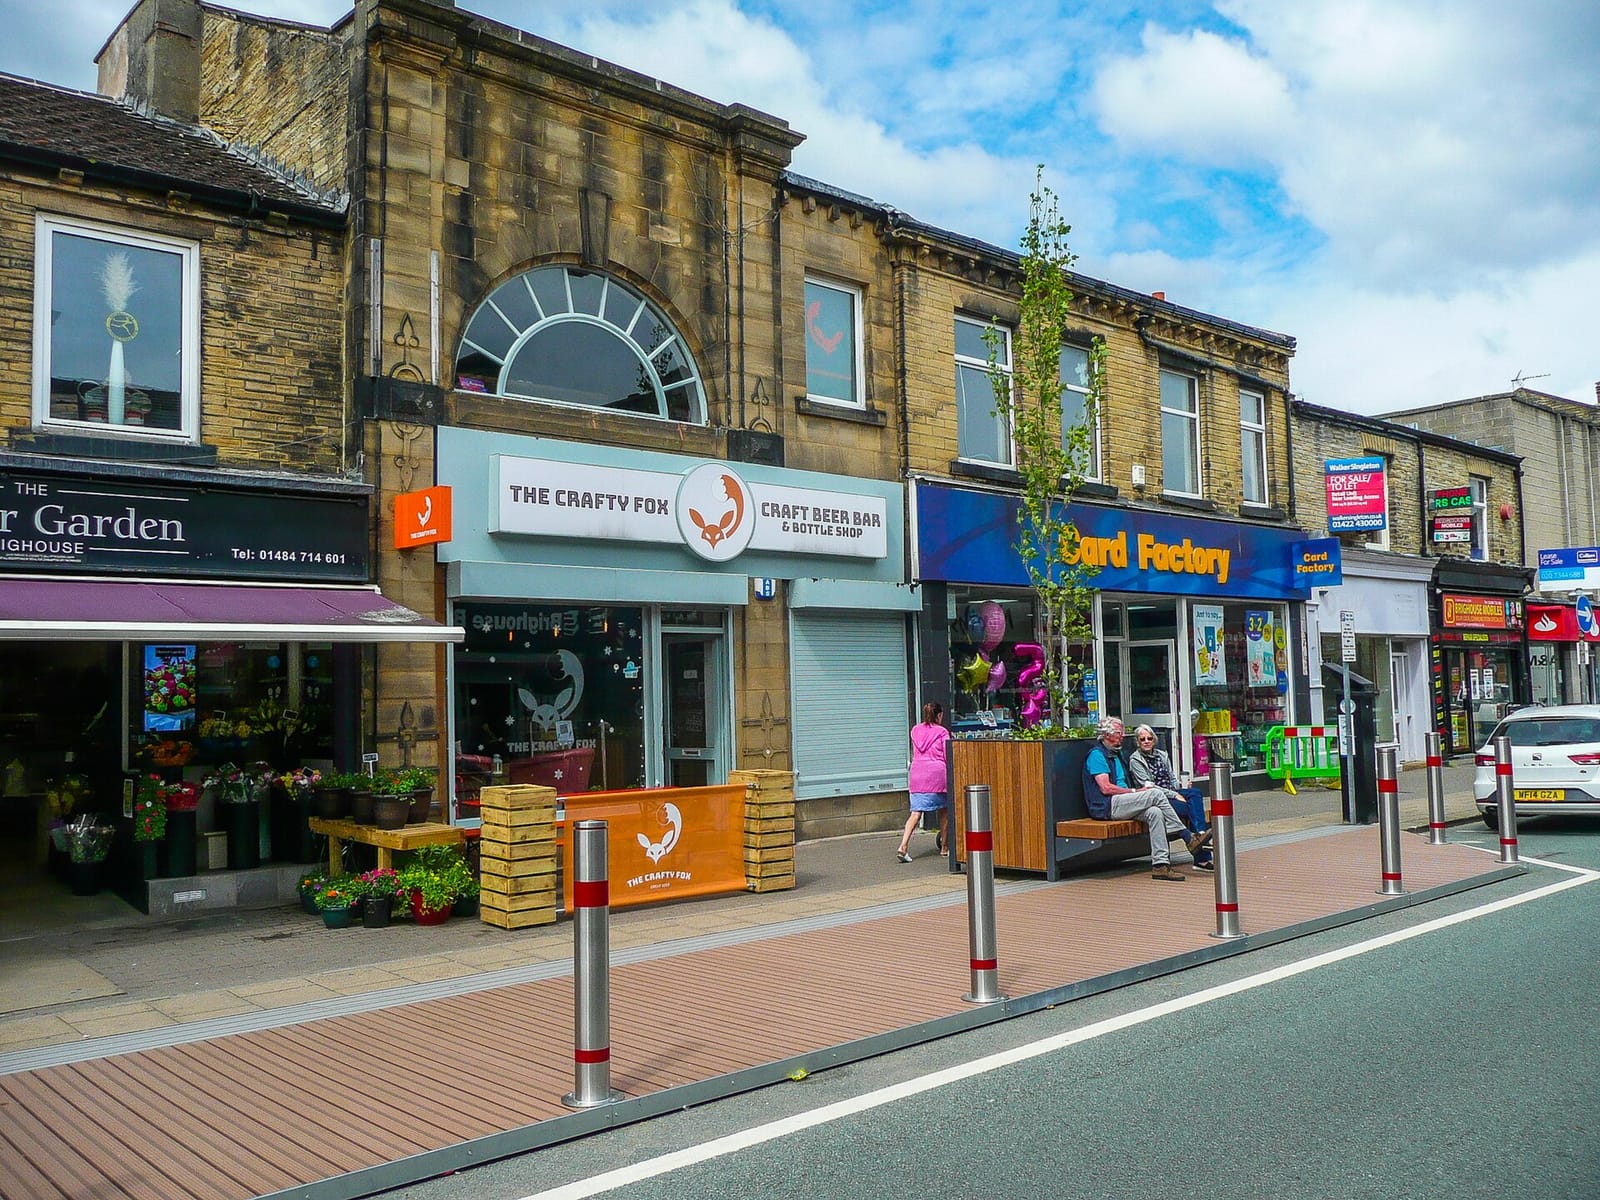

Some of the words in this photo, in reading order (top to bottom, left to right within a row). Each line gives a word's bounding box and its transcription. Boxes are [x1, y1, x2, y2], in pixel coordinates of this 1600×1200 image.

[1330, 475, 1346, 484] FOR
[14, 482, 48, 496] THE
[509, 485, 550, 505] THE
[555, 489, 629, 511] CRAFTY
[633, 497, 669, 515] FOX
[34, 504, 186, 542] Garden
[761, 502, 809, 521] CRAFT
[812, 507, 850, 525] BEER
[853, 511, 881, 528] BAR
[782, 521, 791, 532] &
[792, 523, 834, 536] BOTTLE
[836, 526, 863, 538] SHOP
[231, 548, 256, 561] Tel:
[259, 550, 297, 561] 01484
[300, 552, 321, 562] 714
[325, 553, 346, 564] 601
[1060, 525, 1127, 568] Card
[1137, 533, 1230, 584] Factory
[1303, 552, 1328, 562] Card
[1296, 563, 1335, 573] Factory
[626, 875, 644, 887] THE
[644, 871, 675, 881] CRAFTY
[676, 871, 692, 880] FOX
